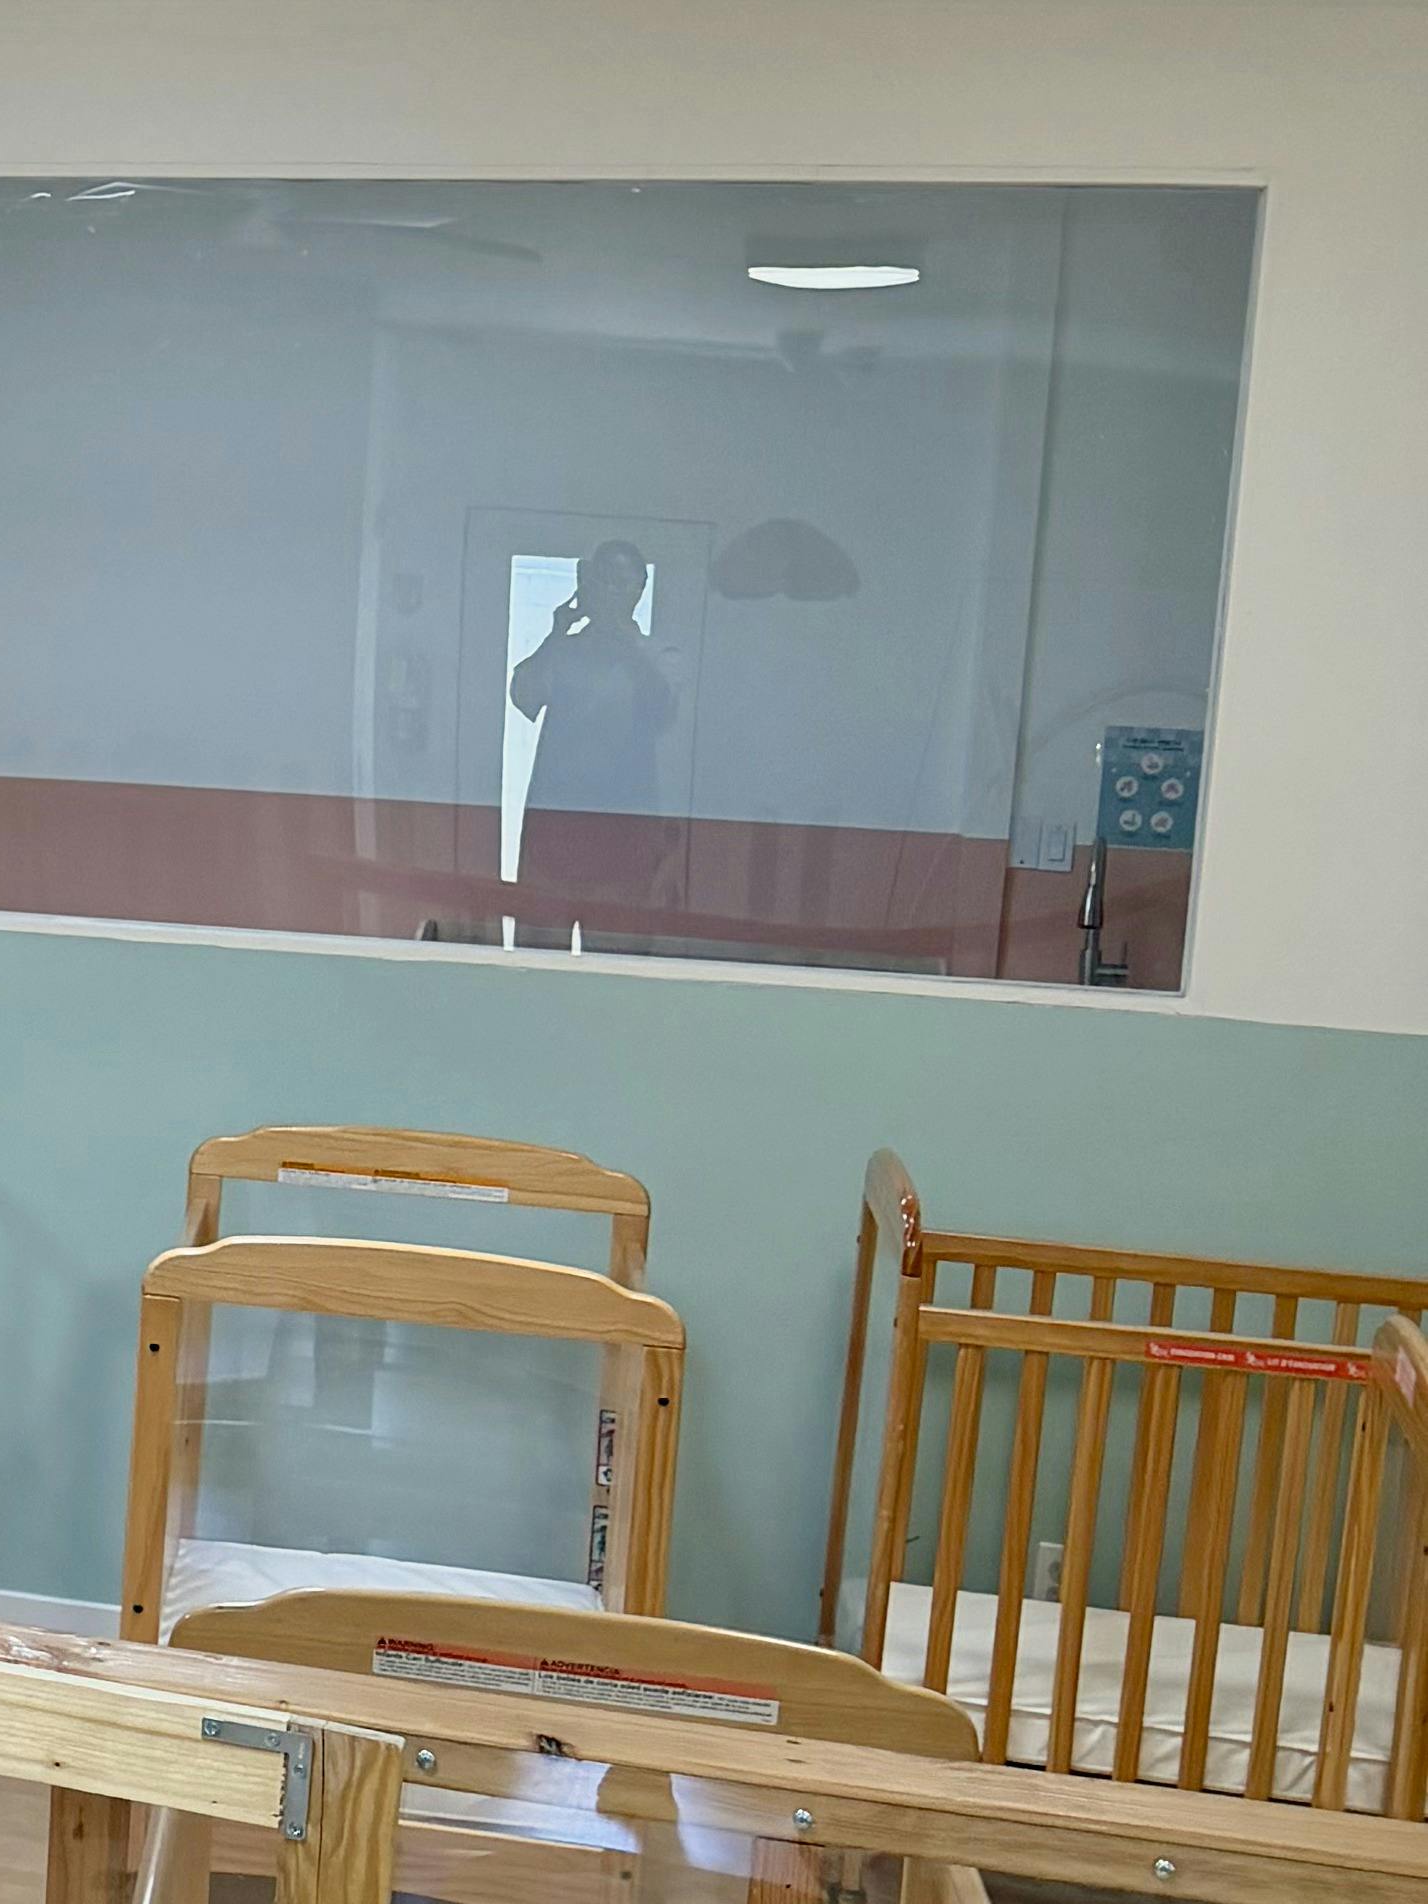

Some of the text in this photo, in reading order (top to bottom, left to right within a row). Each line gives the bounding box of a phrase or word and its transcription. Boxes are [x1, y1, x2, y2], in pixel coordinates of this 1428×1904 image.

[388, 1638, 434, 1651] WARNING
[405, 1652, 422, 1662] Can
[550, 1659, 621, 1675] ADVERTENCIA
